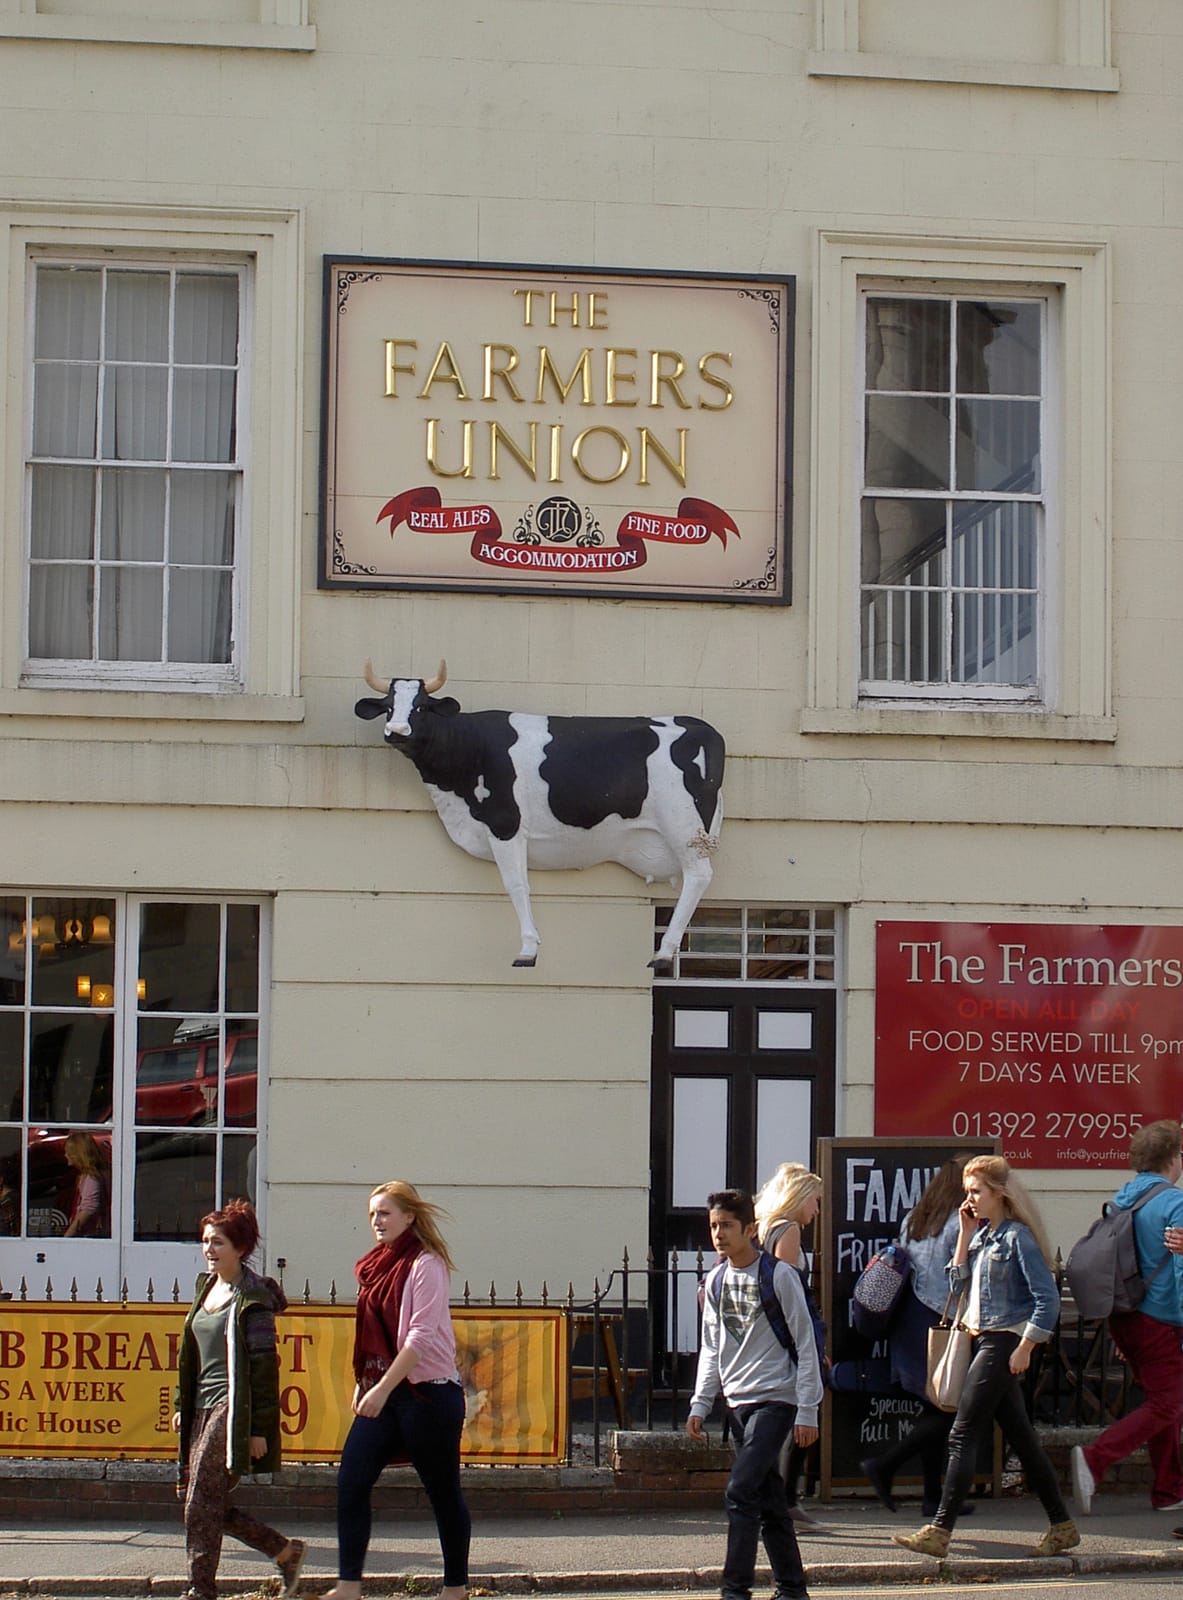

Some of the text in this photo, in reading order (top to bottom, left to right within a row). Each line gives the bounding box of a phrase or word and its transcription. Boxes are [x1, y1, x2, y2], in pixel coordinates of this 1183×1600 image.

[513, 288, 609, 329] THE
[382, 338, 734, 411] FARMERS
[424, 418, 690, 488] UNION
[410, 509, 491, 528] REAL ALES
[627, 515, 707, 539] FINE FOOD
[899, 941, 1183, 987] The Farmers
[957, 998, 1139, 1021] OPEN ALL DAY
[908, 1030, 983, 1052] FOOD
[991, 1031, 1083, 1053] SERVED
[1089, 1032, 1135, 1054] TILL
[958, 1062, 1142, 1085] 7 DAYS A WEEK
[952, 1112, 1143, 1140] 01392 279955
[18, 1380, 36, 1401] A
[43, 1381, 126, 1402] WEEK
[155, 1386, 170, 1433] from
[868, 1397, 925, 1421] Specials
[36, 1411, 122, 1434] House
